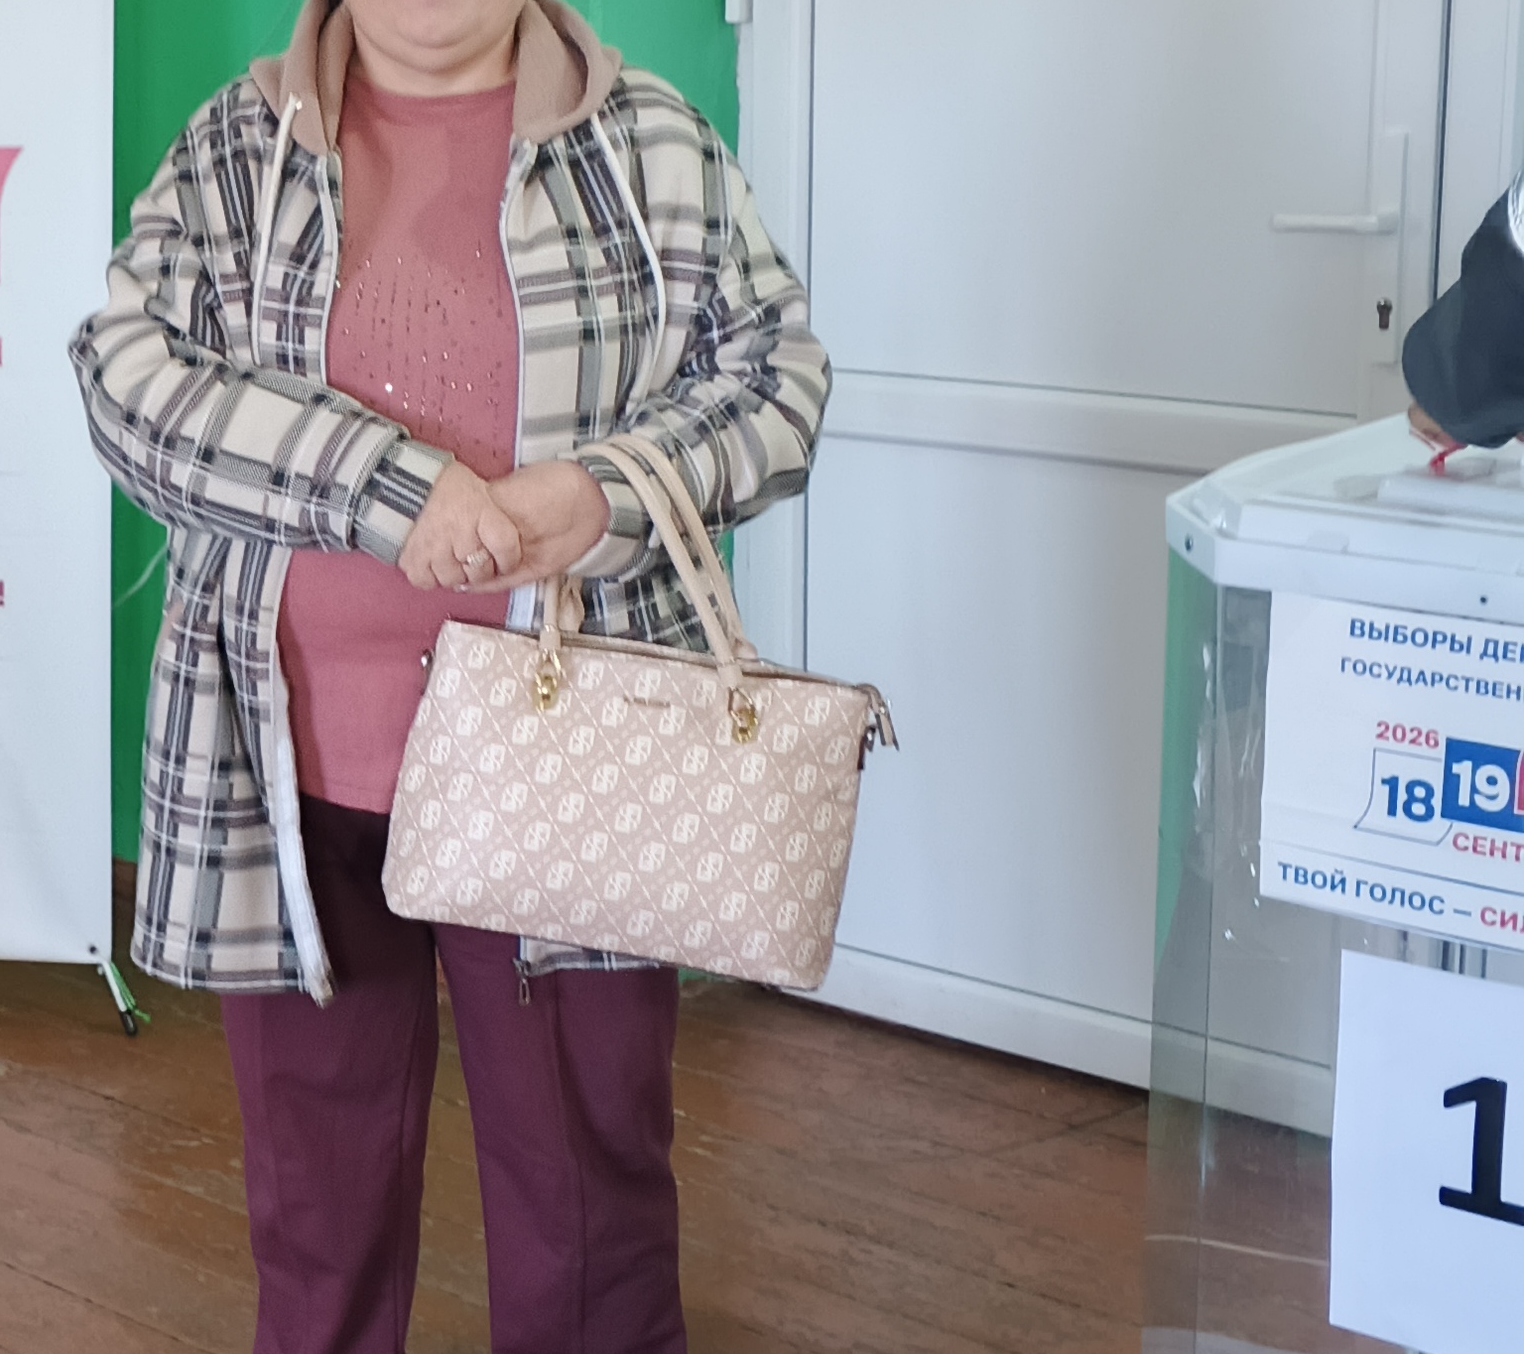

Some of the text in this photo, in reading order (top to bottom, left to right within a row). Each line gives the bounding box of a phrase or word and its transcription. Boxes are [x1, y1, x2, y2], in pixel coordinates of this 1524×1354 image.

[1349, 617, 1524, 663] ВЫБОРЫ ДЕ
[1375, 720, 1440, 749] 2026
[1380, 759, 1511, 823] 18 19
[1452, 832, 1524, 862] СЕНТ
[1277, 861, 1347, 895] ТВОЙ
[1355, 878, 1445, 915] ГОЛОС
[1480, 906, 1524, 934] СИ
[1439, 1077, 1524, 1227] 1
